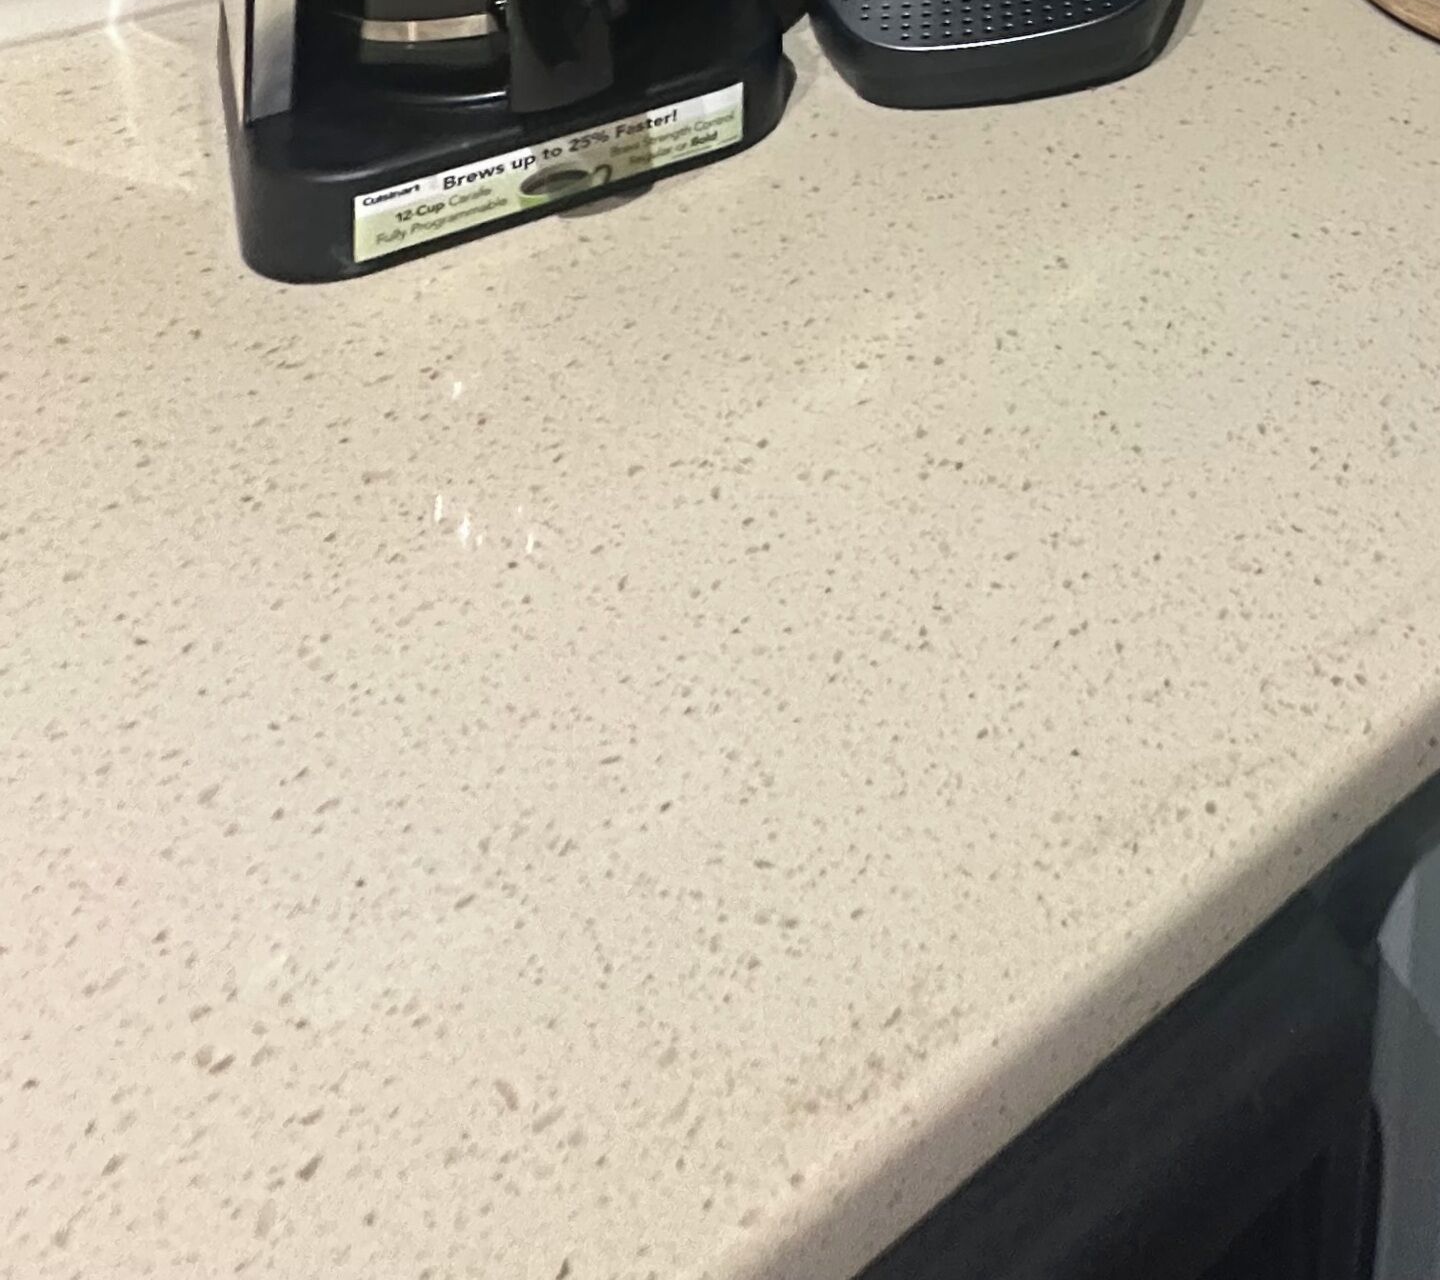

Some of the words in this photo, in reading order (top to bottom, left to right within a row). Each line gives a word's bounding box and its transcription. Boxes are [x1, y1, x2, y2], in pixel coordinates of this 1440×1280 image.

[442, 162, 505, 191] Brews
[511, 154, 537, 171] up
[541, 146, 563, 160] to
[568, 132, 610, 153] 25%
[614, 108, 678, 139] Faster!
[689, 130, 719, 148] Bold
[362, 183, 421, 207] Cuisinart
[394, 201, 446, 223] 12-Cup
[448, 186, 493, 207] Carafe
[375, 228, 407, 245] Fully
[410, 196, 508, 235] Programmable
